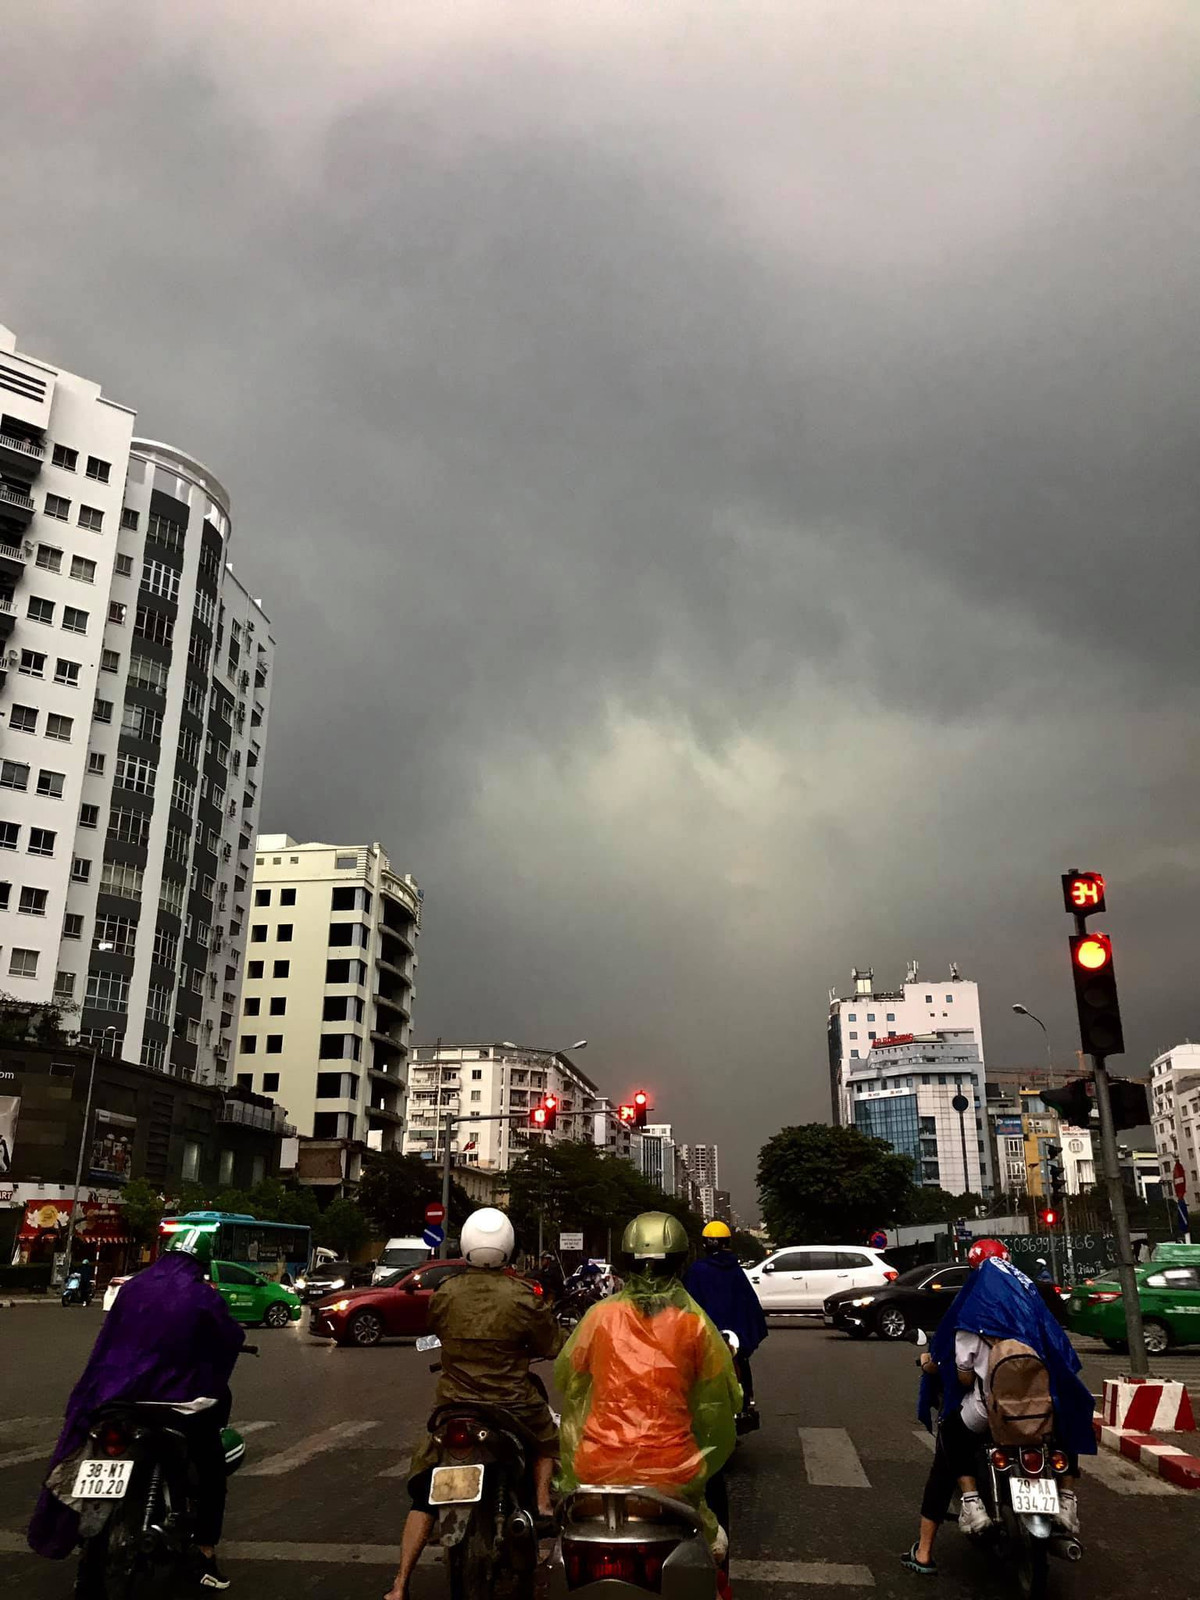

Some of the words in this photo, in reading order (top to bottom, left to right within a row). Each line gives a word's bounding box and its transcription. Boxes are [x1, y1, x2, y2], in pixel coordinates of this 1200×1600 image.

[1072, 881, 1099, 905] 34
[620, 1106, 634, 1120] 34
[80, 1479, 124, 1495] 110.20
[1017, 1479, 1051, 1495] 29-AA
[1015, 1496, 1056, 1512] 334.27
